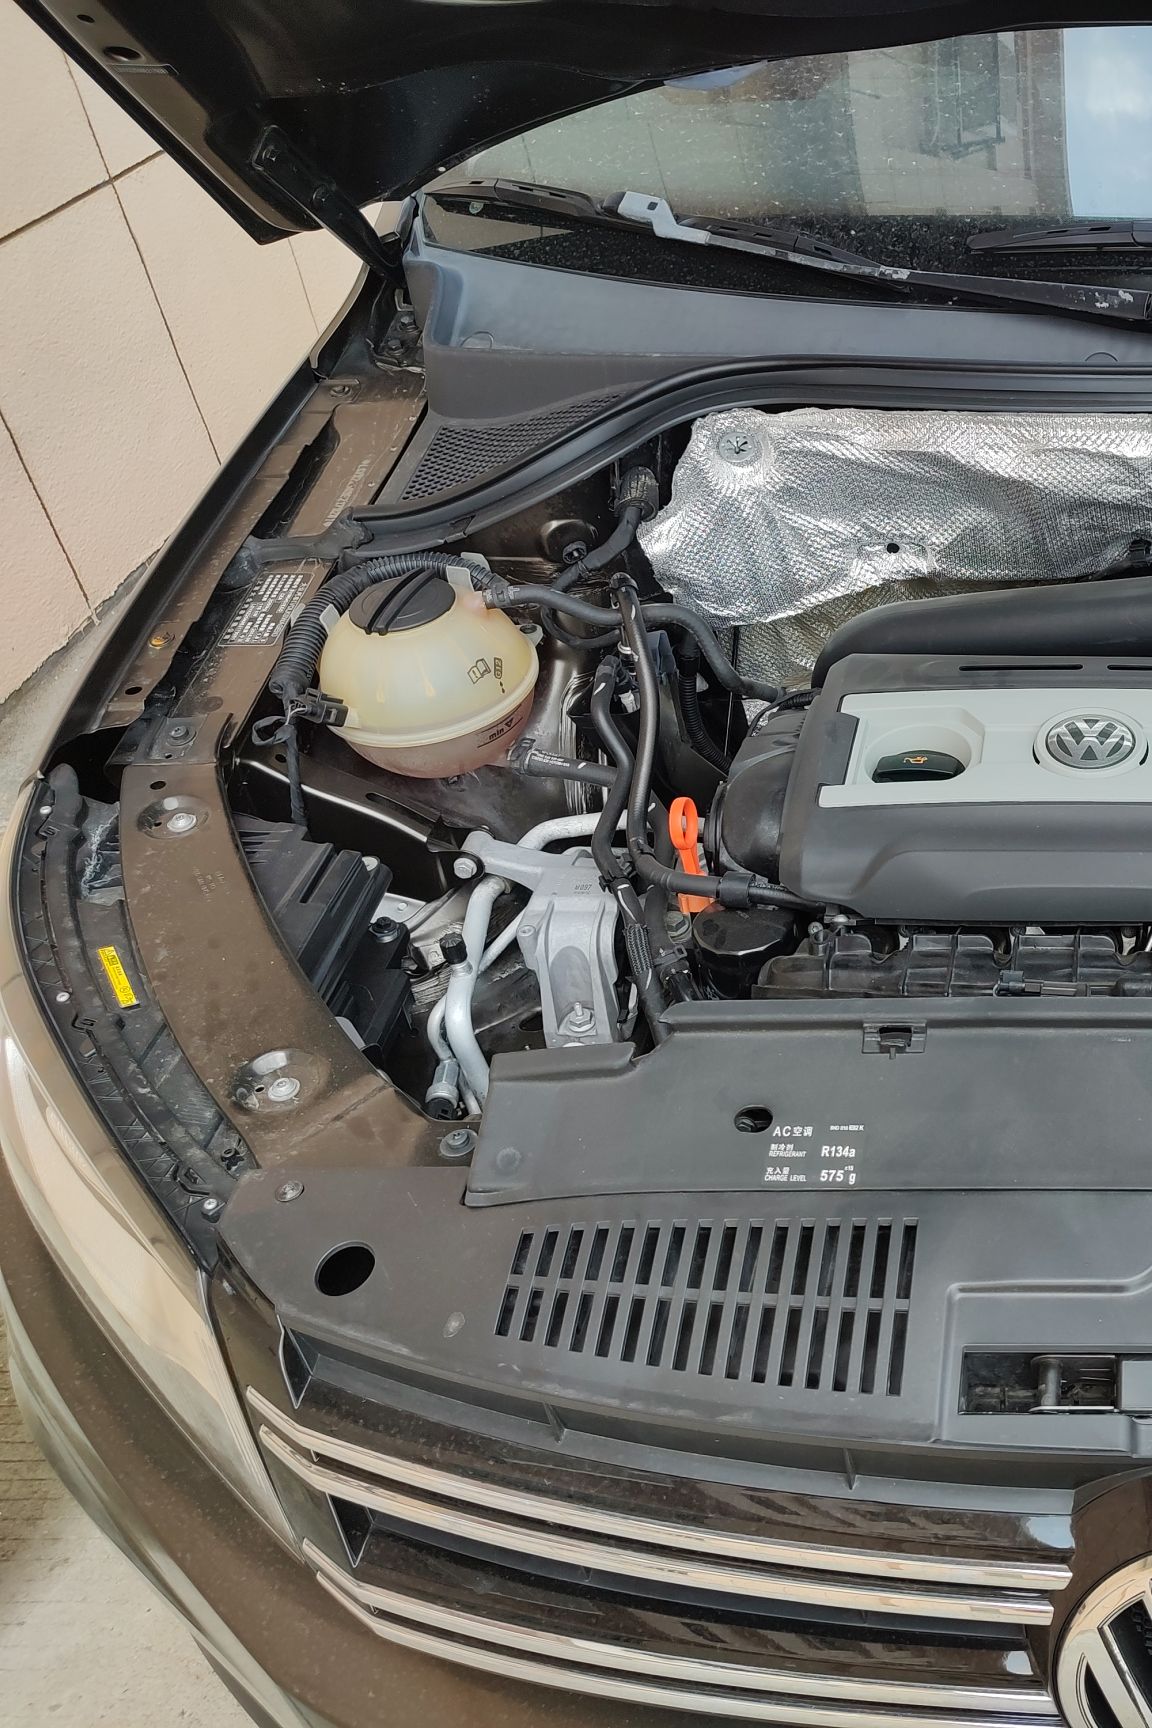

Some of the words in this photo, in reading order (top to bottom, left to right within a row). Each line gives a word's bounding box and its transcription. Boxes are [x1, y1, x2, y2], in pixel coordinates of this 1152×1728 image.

[494, 658, 502, 678] G12
[489, 728, 504, 740] min
[821, 1145, 856, 1157] R134a
[820, 1169, 844, 1181] 575
[849, 1173, 856, 1185] g
